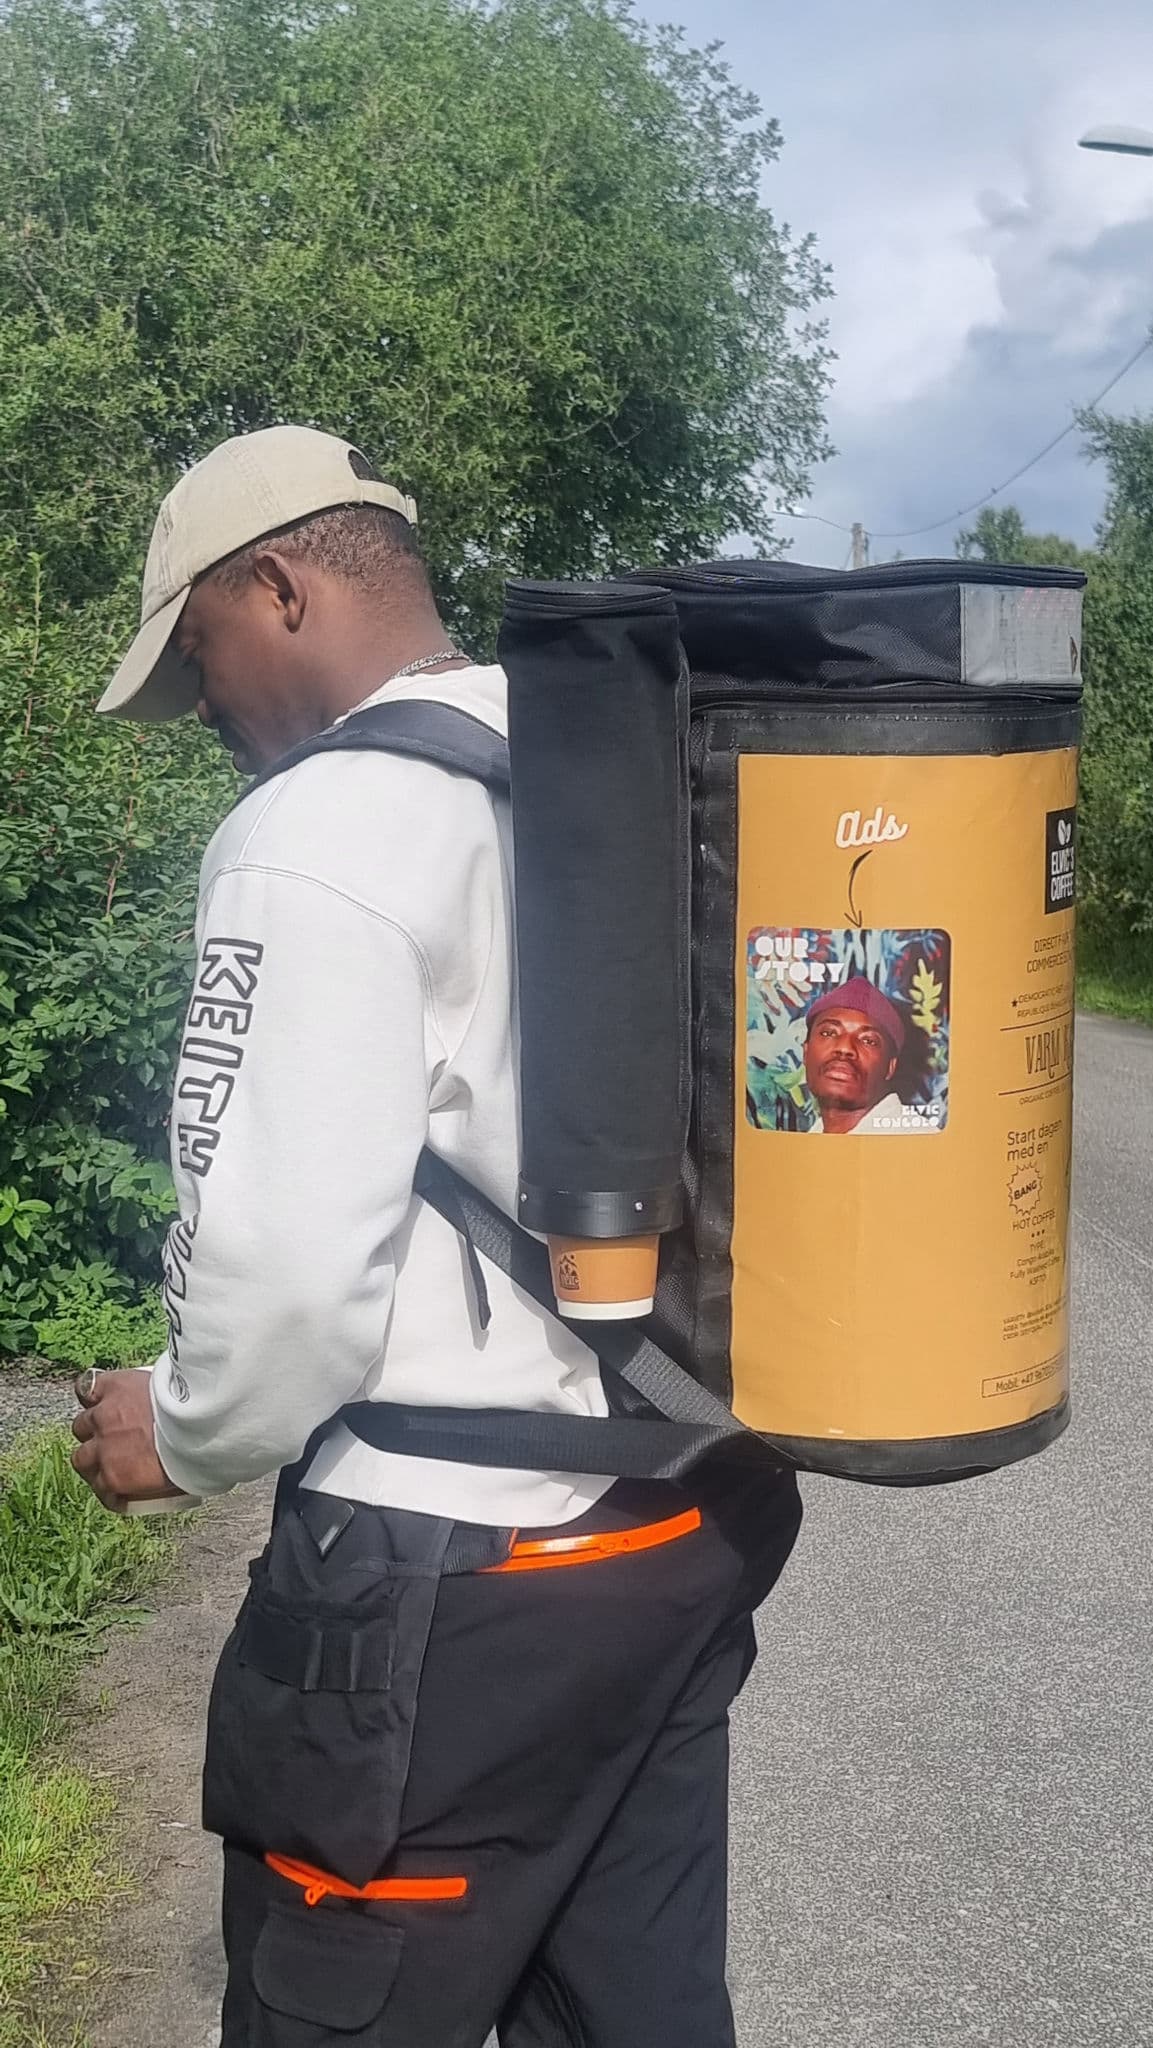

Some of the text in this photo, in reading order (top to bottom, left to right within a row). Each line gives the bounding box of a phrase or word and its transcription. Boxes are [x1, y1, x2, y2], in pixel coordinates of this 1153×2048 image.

[754, 935, 809, 959] OUR
[754, 960, 845, 983] STORY
[179, 937, 264, 1178] KEITH
[901, 1104, 940, 1116] ELVIC
[872, 1116, 940, 1128] KONGOLO
[1007, 1127, 1036, 1146] Start
[1007, 1141, 1049, 1161] med en
[1013, 1180, 1038, 1200] BANG
[1012, 1217, 1031, 1231] HOT
